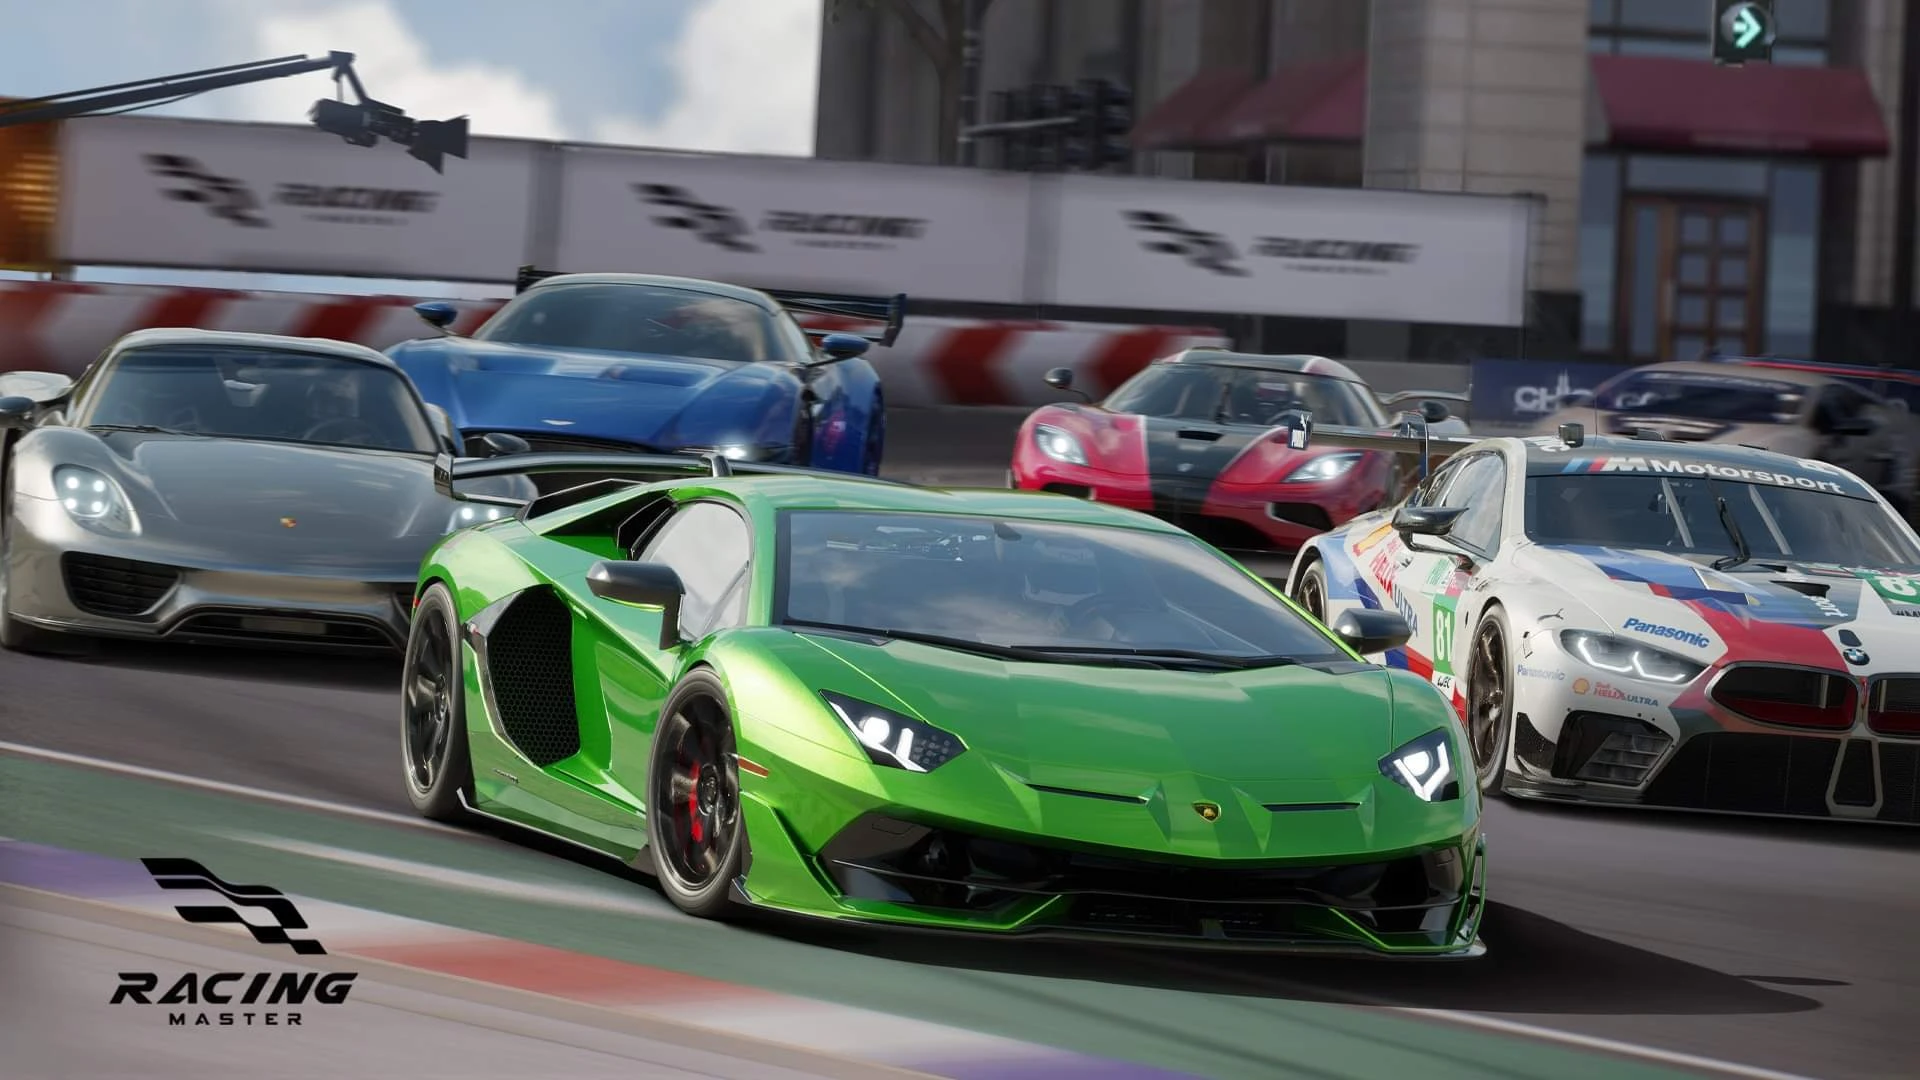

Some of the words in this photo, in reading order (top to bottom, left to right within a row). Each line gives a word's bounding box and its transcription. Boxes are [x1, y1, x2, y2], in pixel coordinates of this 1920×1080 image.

[1650, 458, 1846, 495] Motorsport
[1394, 584, 1418, 637] ULTRA
[1435, 609, 1452, 662] 81
[1623, 617, 1710, 649] Panasonic
[1517, 663, 1566, 682] Panasonic
[1627, 693, 1660, 708] ULTRA
